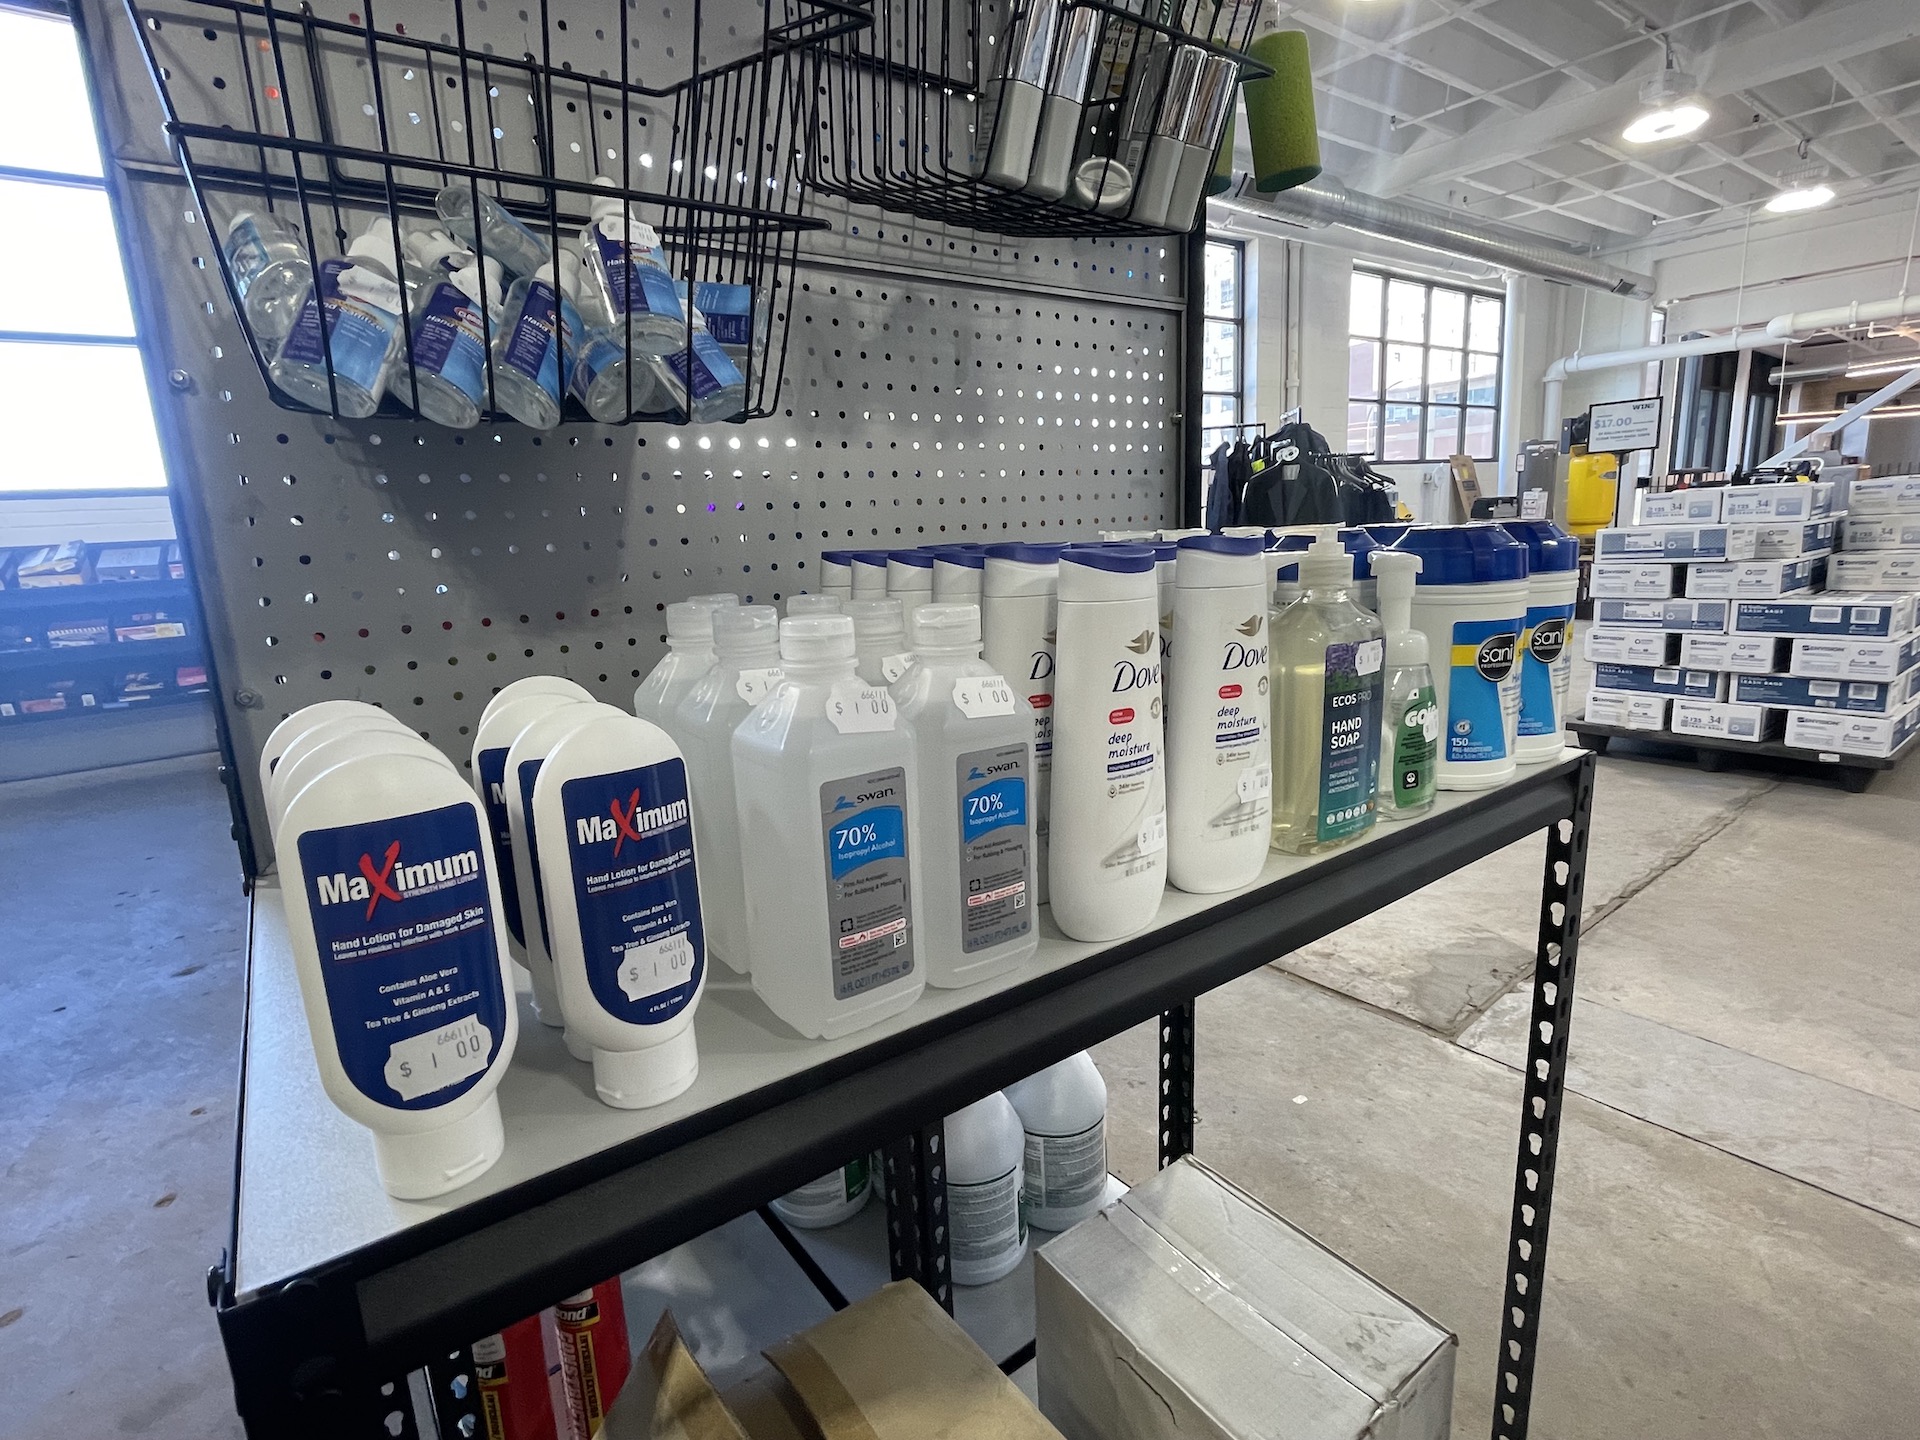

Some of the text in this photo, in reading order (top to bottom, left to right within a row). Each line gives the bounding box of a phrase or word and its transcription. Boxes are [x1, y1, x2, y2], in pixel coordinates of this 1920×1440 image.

[307, 299, 337, 310] Hnd
[426, 314, 454, 328] Hand
[523, 314, 548, 332] Hand
[1594, 417, 1632, 430] $17.00
[1670, 502, 1682, 511] 34
[1756, 499, 1769, 508] 34
[1534, 628, 1563, 646] sani
[1222, 641, 1268, 671] Dove
[1481, 644, 1513, 663] sani
[1112, 660, 1160, 692] Dove
[745, 682, 753, 693] $
[861, 690, 887, 700] 666111
[961, 692, 970, 705] $
[992, 690, 1009, 703] 00
[1332, 690, 1372, 708] ECOS PRO
[835, 701, 844, 716] $
[871, 700, 889, 714] 00
[1217, 706, 1240, 719] deep
[1217, 715, 1257, 730] moisture
[1331, 716, 1362, 735] HAND
[1708, 715, 1721, 724] 34
[1108, 732, 1133, 746] deep
[1330, 732, 1360, 749] SOAP
[1451, 737, 1468, 747] 150
[1108, 742, 1151, 759] moisture
[986, 761, 1019, 775] swan
[856, 787, 894, 804] swan
[968, 792, 1003, 816] 70%
[576, 787, 688, 859] MaXimum
[969, 814, 997, 826] Isopropyl
[835, 822, 876, 850] 70%
[838, 838, 896, 860] Isopropyl Alcohol
[586, 847, 692, 886] Hand Lotion for Damaged Skin
[317, 840, 479, 922] MaXimum
[622, 899, 678, 923] Contains Aloe Vera
[331, 906, 484, 952] Hand Lotion for Damaged Skin
[632, 920, 657, 933] Vitamin
[333, 951, 358, 961] Leaves
[368, 943, 393, 954] residue
[393, 941, 401, 949] to
[401, 936, 429, 948] interfere
[429, 931, 443, 940] with
[443, 926, 460, 936] work
[611, 945, 624, 954] Tea
[659, 937, 685, 954] 666111
[629, 967, 639, 982] $
[670, 950, 687, 970] 00
[378, 966, 458, 995] Contains Aloe Vera
[392, 983, 451, 1007] Vitamin A & E
[364, 989, 480, 1030] Tea Tree & Ginseng Extracts
[437, 1022, 476, 1046] 666111
[399, 1034, 480, 1078] $ 1 00
[556, 1306, 588, 1321] ond
